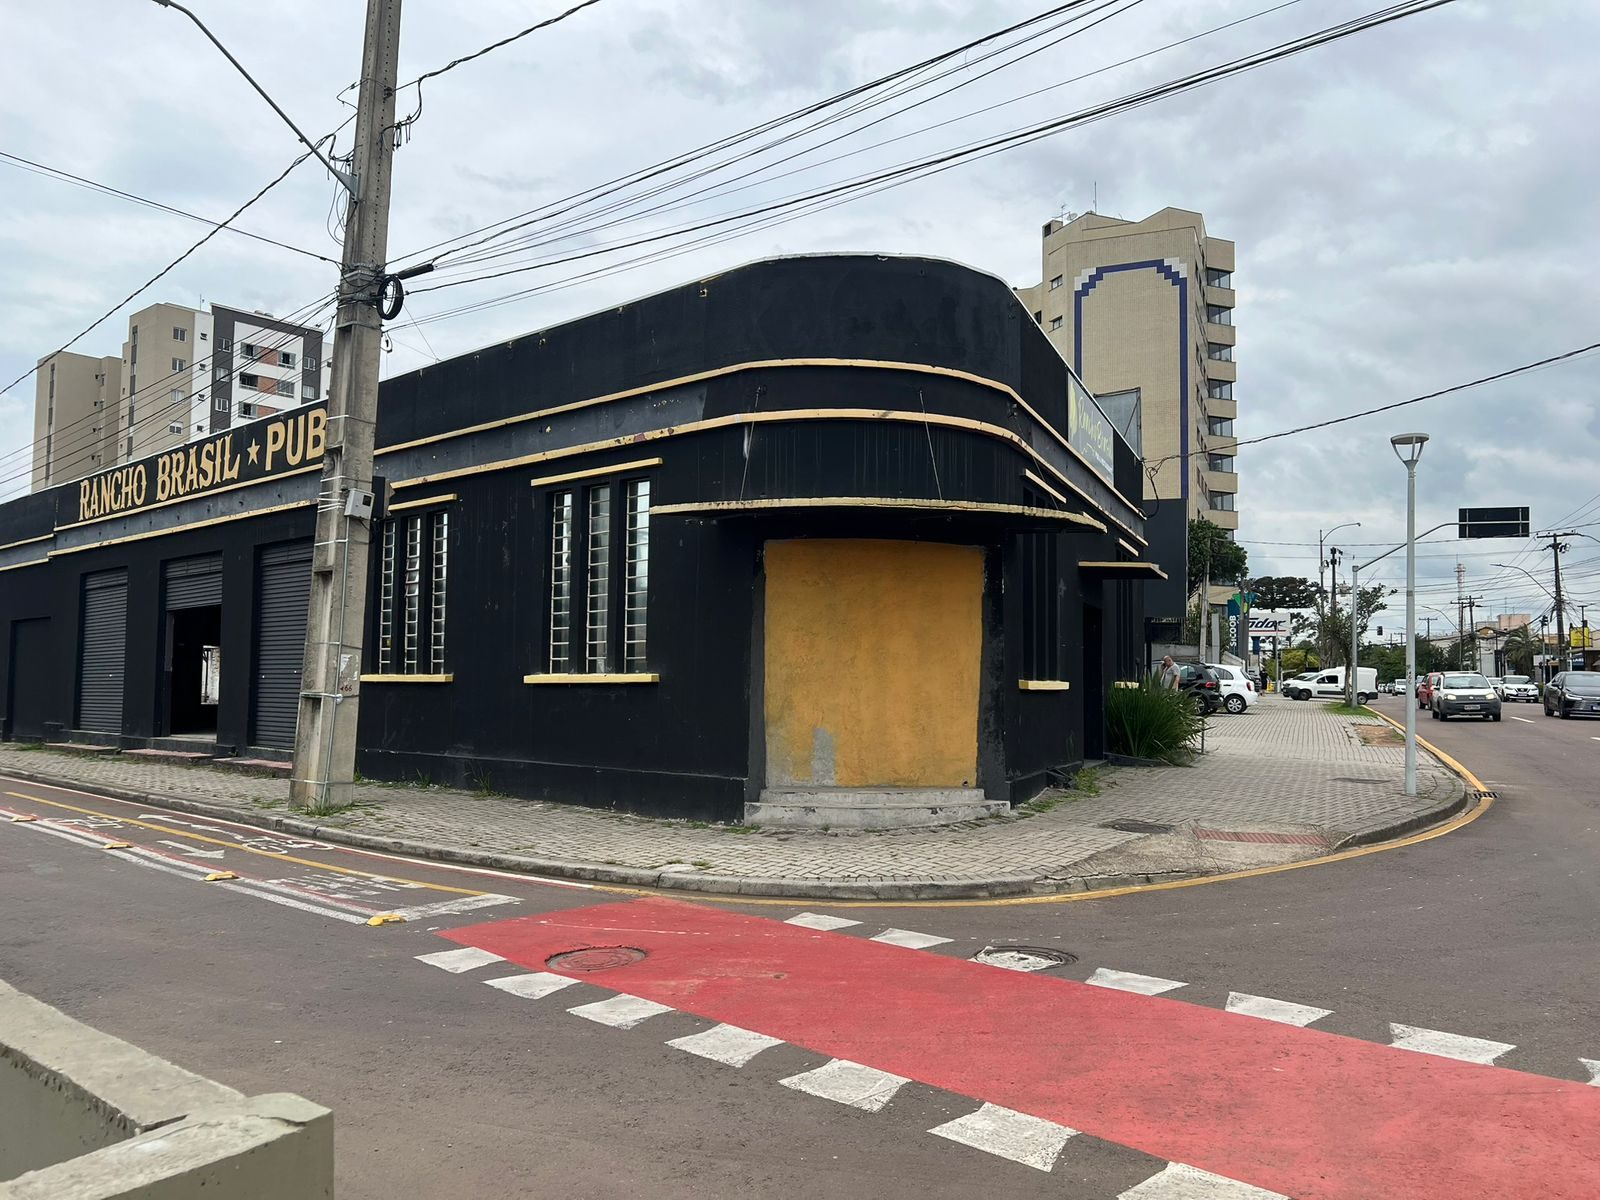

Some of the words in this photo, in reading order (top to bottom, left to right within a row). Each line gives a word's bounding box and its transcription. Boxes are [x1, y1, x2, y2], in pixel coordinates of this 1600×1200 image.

[78, 464, 147, 522] RANCHO
[156, 433, 241, 501] BRASIL
[265, 407, 328, 471] PUB
[1229, 615, 1237, 647] SICOOB
